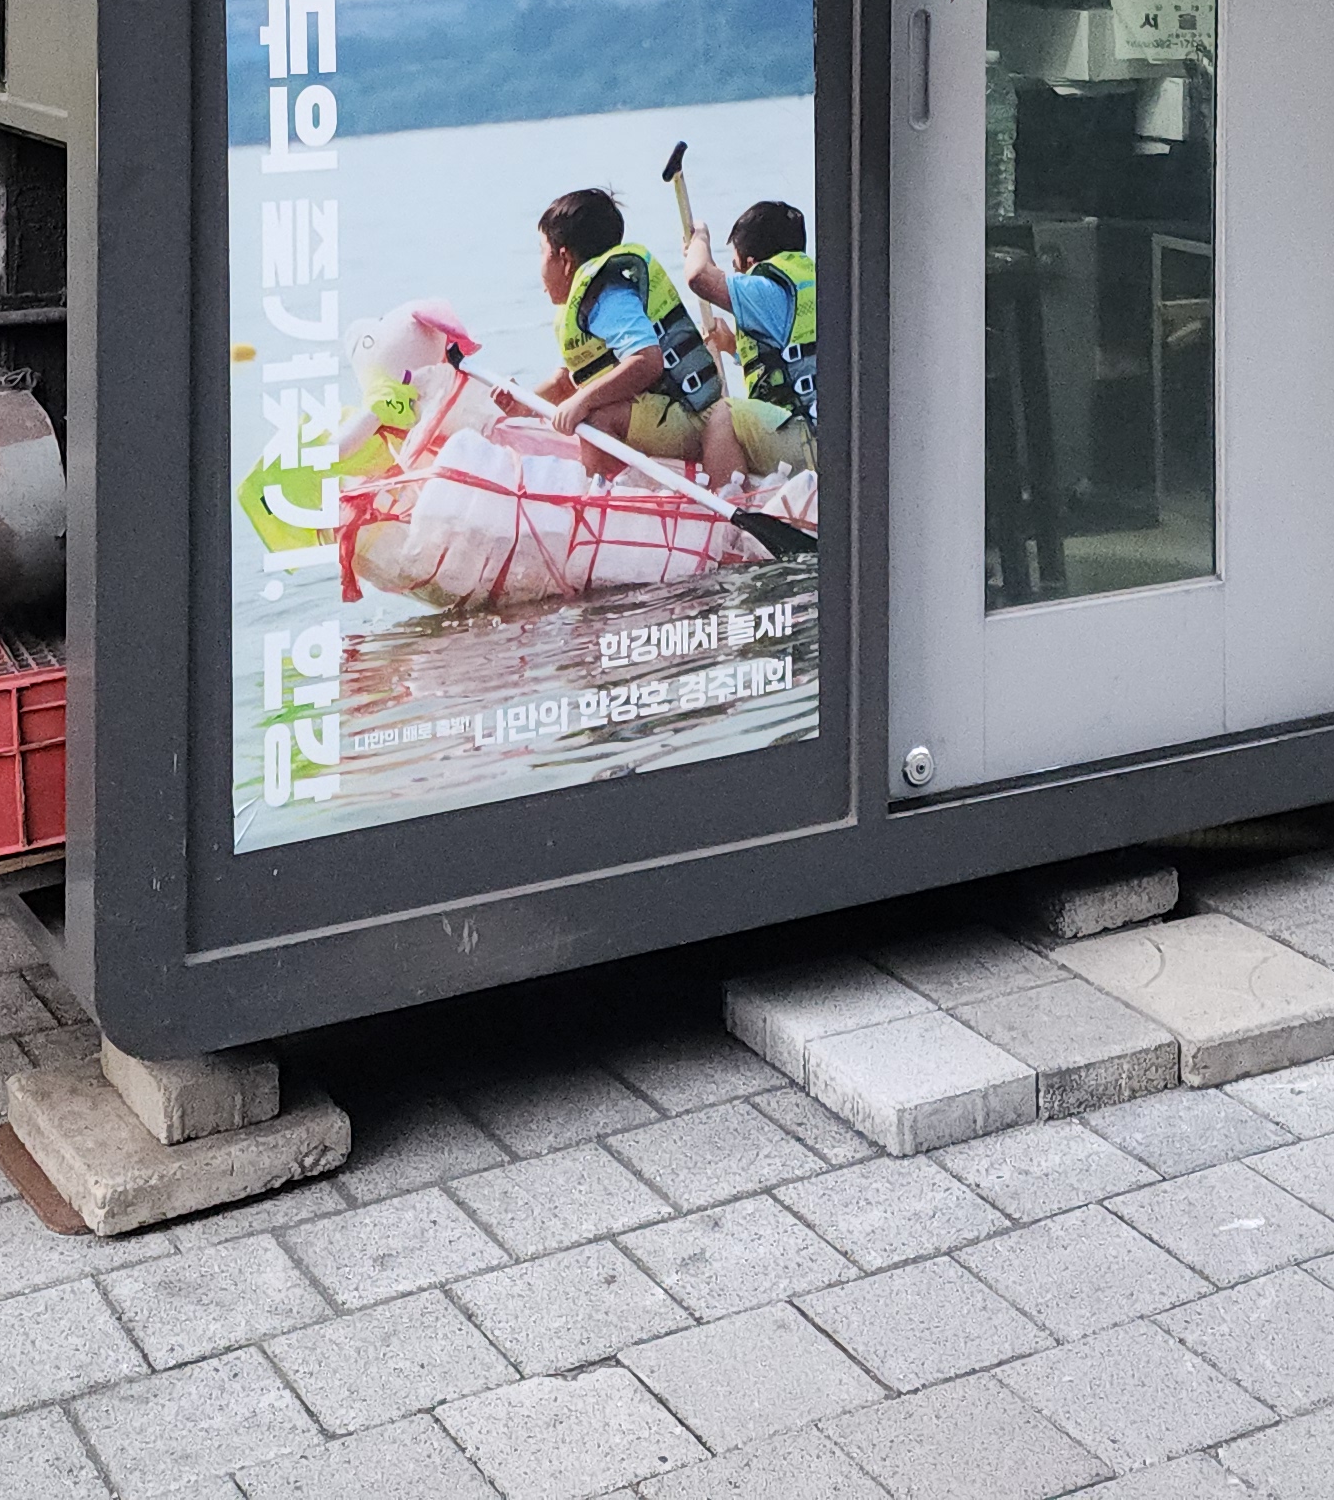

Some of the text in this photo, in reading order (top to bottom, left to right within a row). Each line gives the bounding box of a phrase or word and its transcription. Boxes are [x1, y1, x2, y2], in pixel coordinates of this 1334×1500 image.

[261, 198, 341, 603] 즐겨찾기,
[598, 603, 793, 669] 한강에서 놀자!
[262, 619, 341, 809] 한강
[354, 728, 399, 752] 나만의
[403, 721, 433, 743] 배로
[473, 656, 794, 748] 나만의 한강호 경주대회
